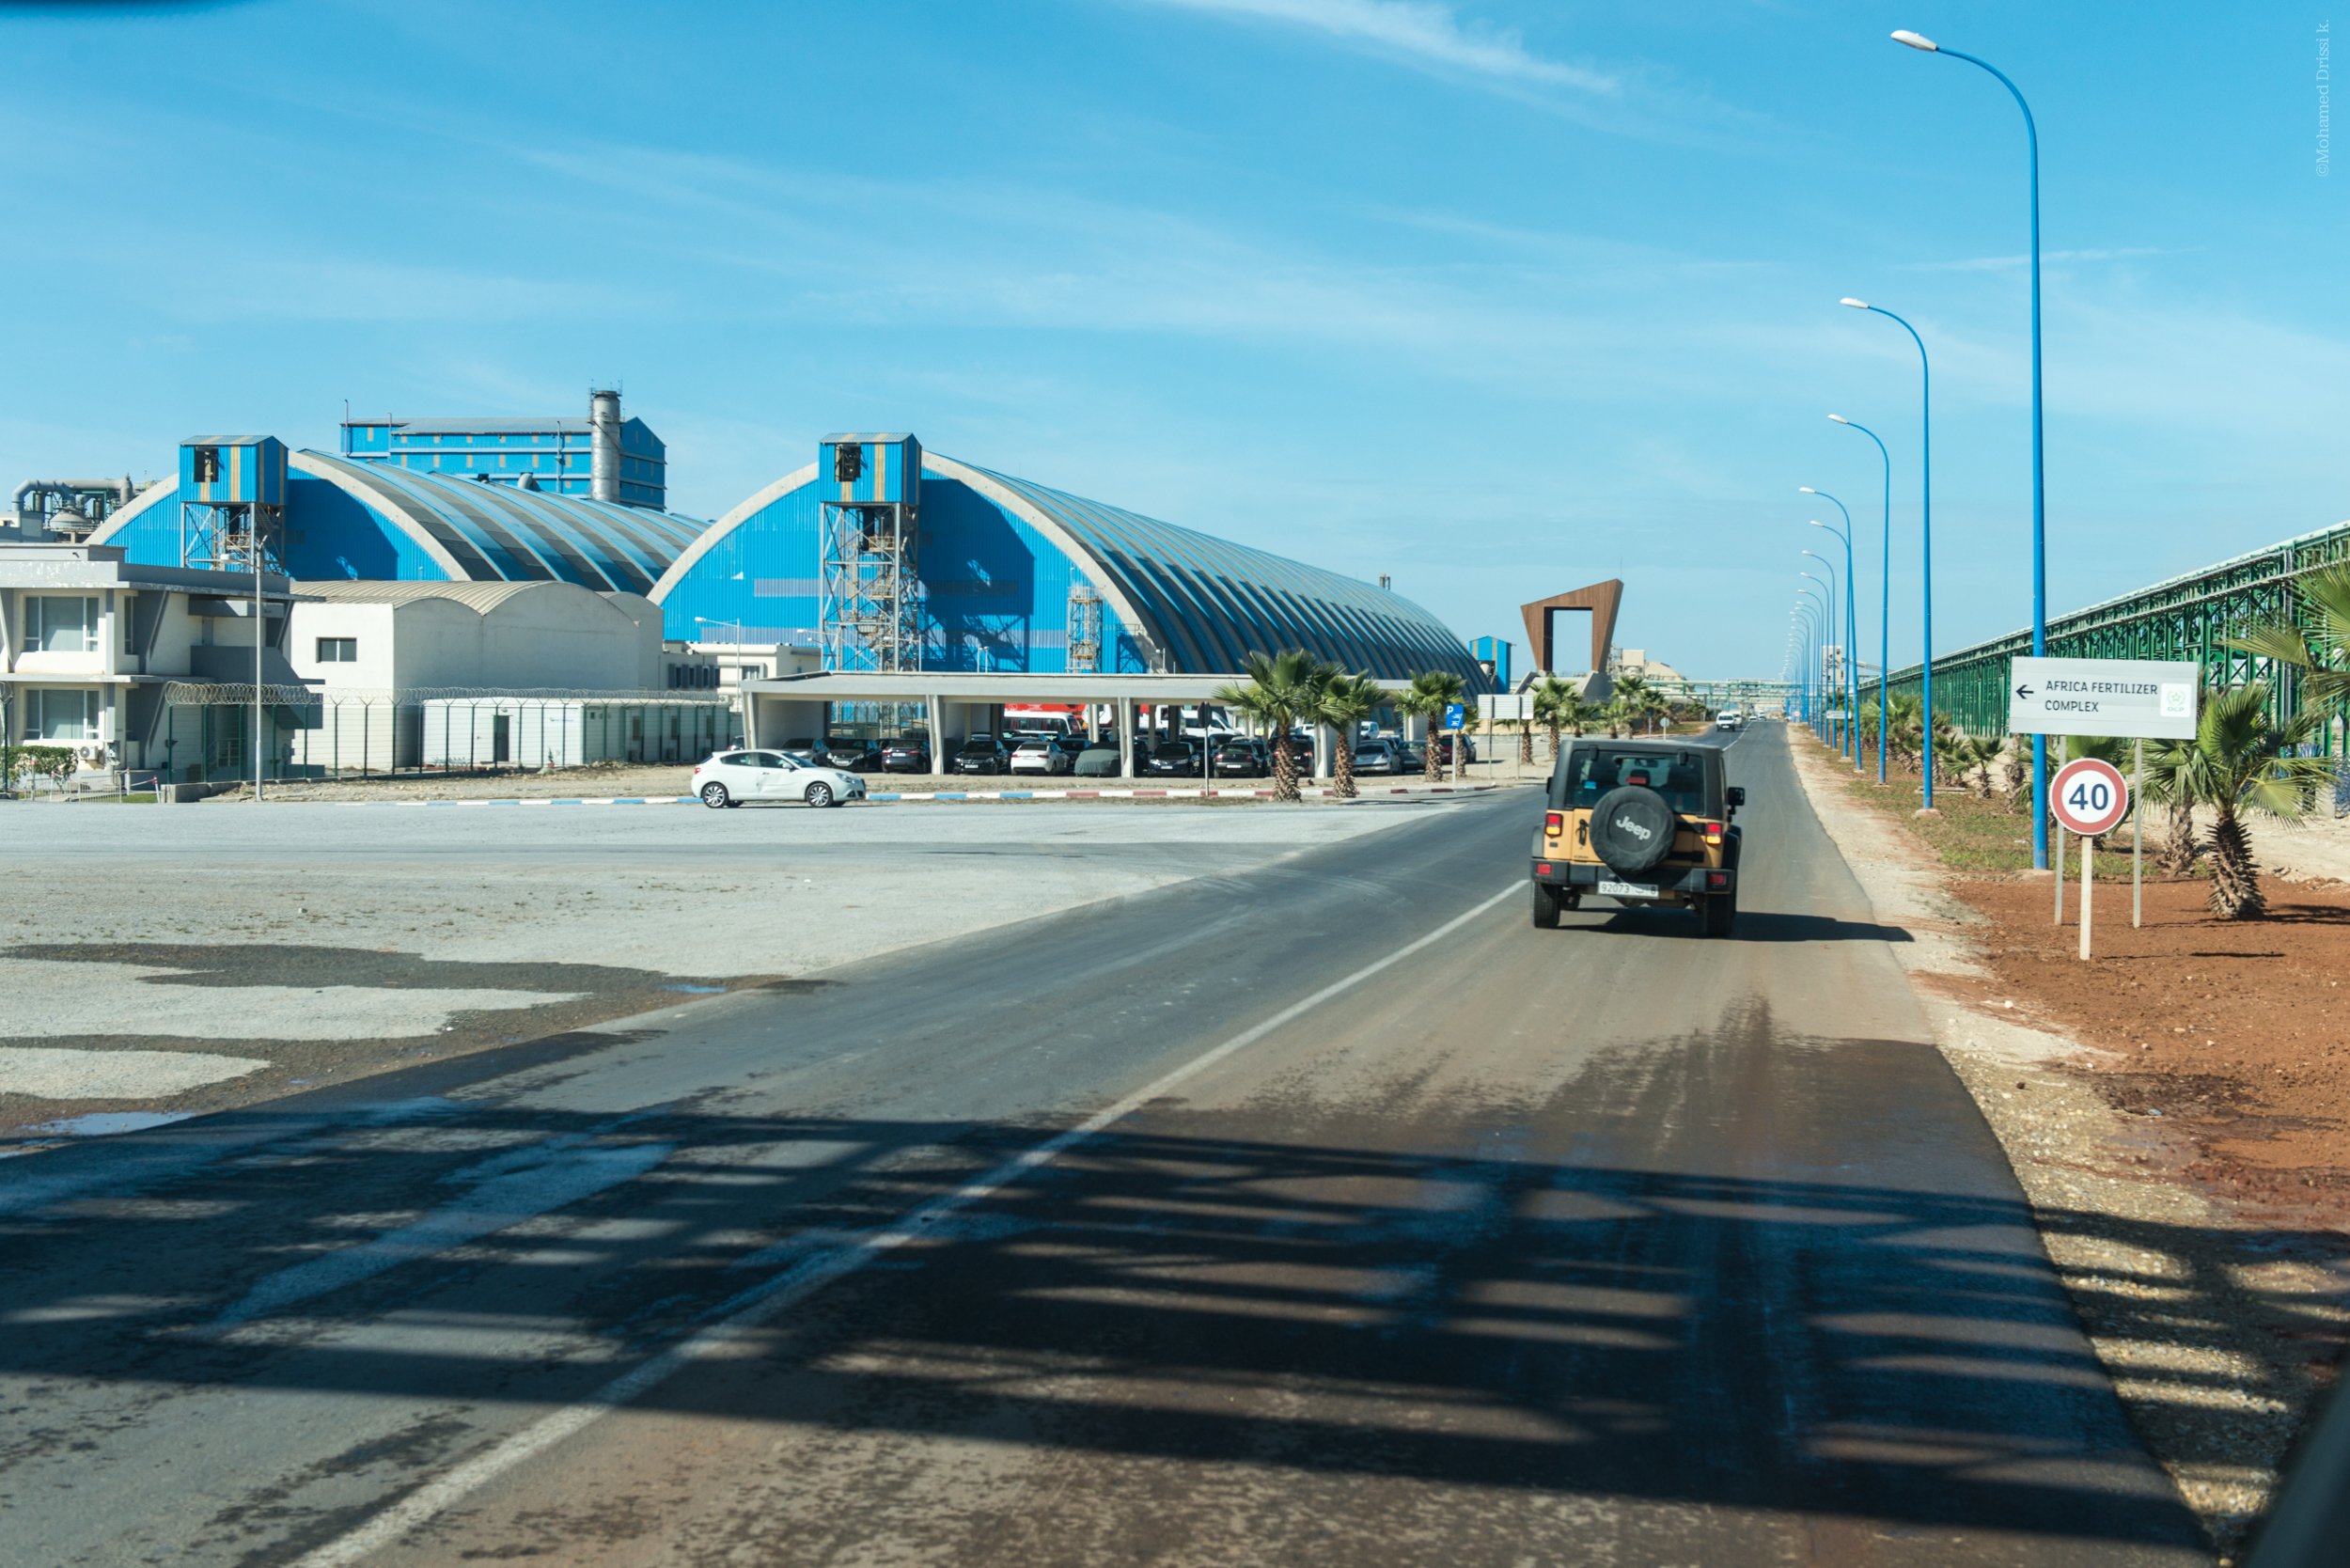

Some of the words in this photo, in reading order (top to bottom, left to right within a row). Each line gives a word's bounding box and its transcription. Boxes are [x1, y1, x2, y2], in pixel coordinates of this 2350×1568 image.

[2045, 681, 2088, 692] AFRICA
[2092, 682, 2158, 695] FERTILIZER
[1447, 706, 1454, 714] P
[2044, 700, 2099, 712] COMPLEX
[2069, 783, 2109, 810] 40
[1615, 815, 1652, 840] Jeep
[1602, 884, 1630, 894] 92073
